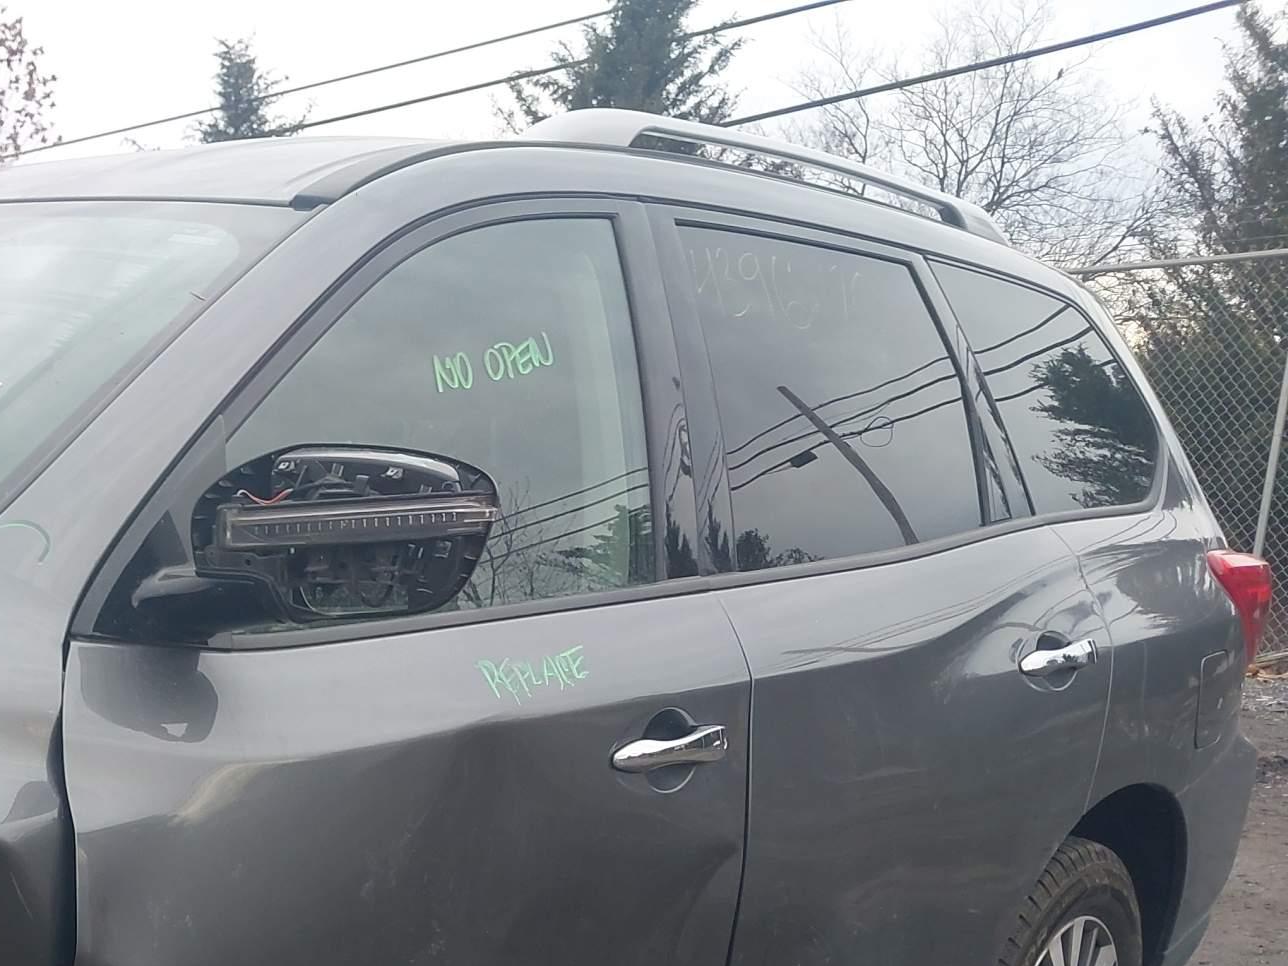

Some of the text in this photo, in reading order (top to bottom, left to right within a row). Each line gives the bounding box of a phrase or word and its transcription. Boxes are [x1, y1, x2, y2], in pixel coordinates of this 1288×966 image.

[432, 331, 554, 393] NO OPEN
[474, 644, 590, 706] REPLACE
